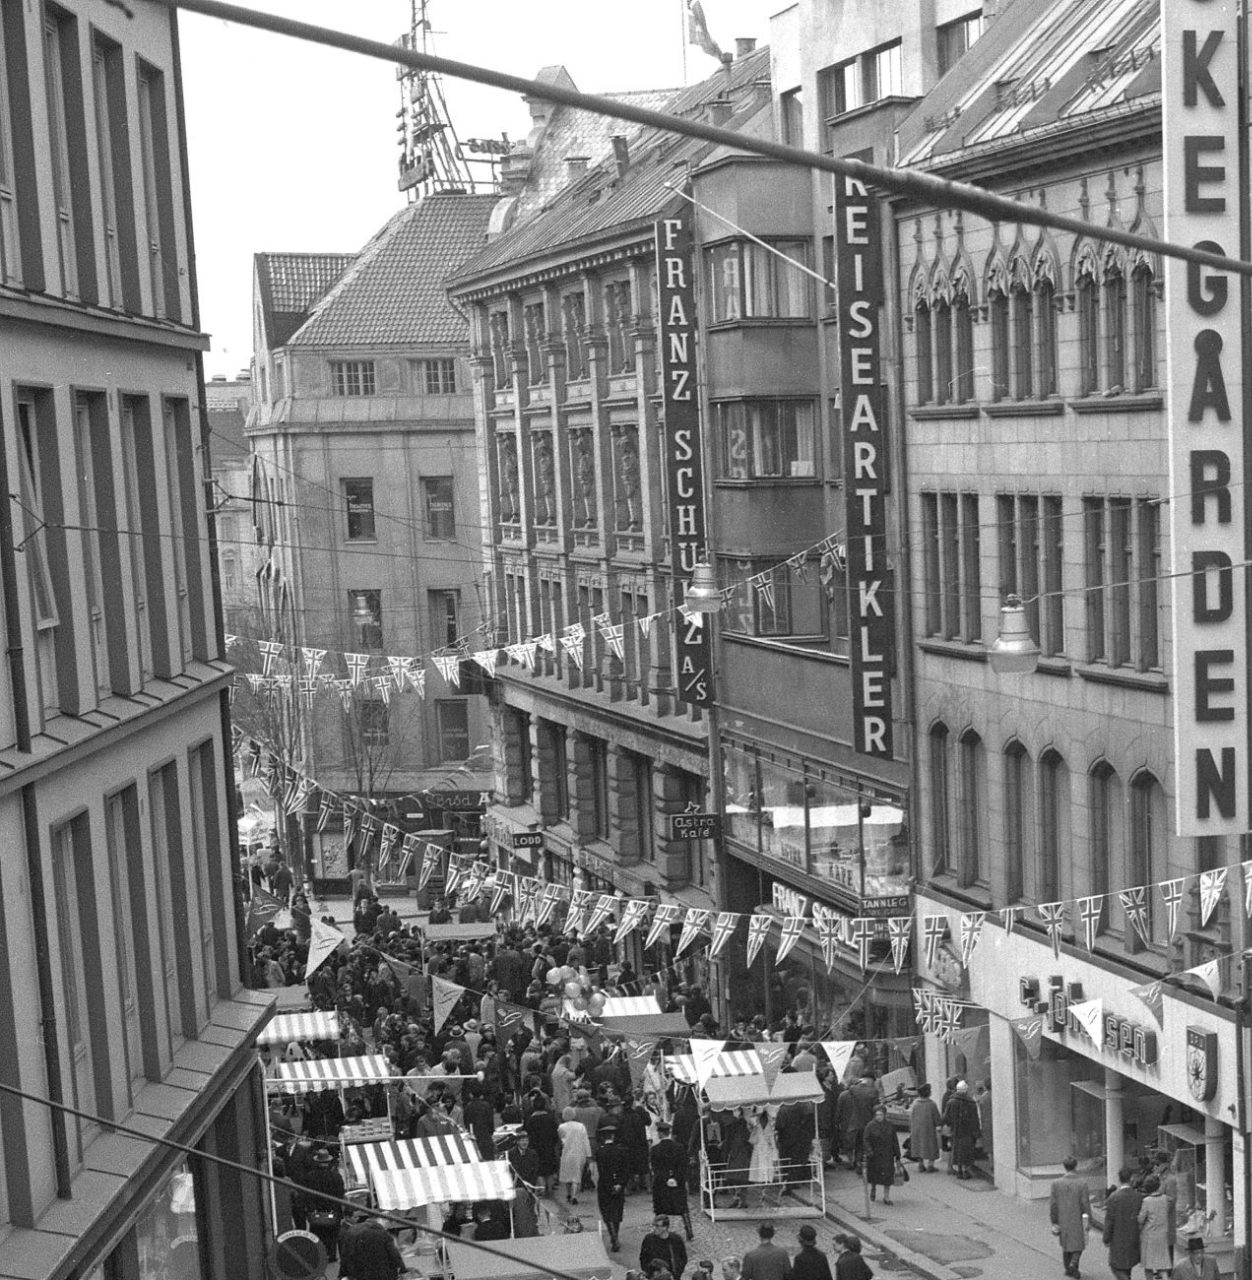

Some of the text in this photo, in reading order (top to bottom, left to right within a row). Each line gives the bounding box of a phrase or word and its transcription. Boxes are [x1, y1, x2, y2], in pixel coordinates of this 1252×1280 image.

[663, 218, 708, 701] FRANZ SCHUZ A/S
[1182, 0, 1239, 820] KEGÅRDEN
[772, 881, 807, 918] FRANZ
